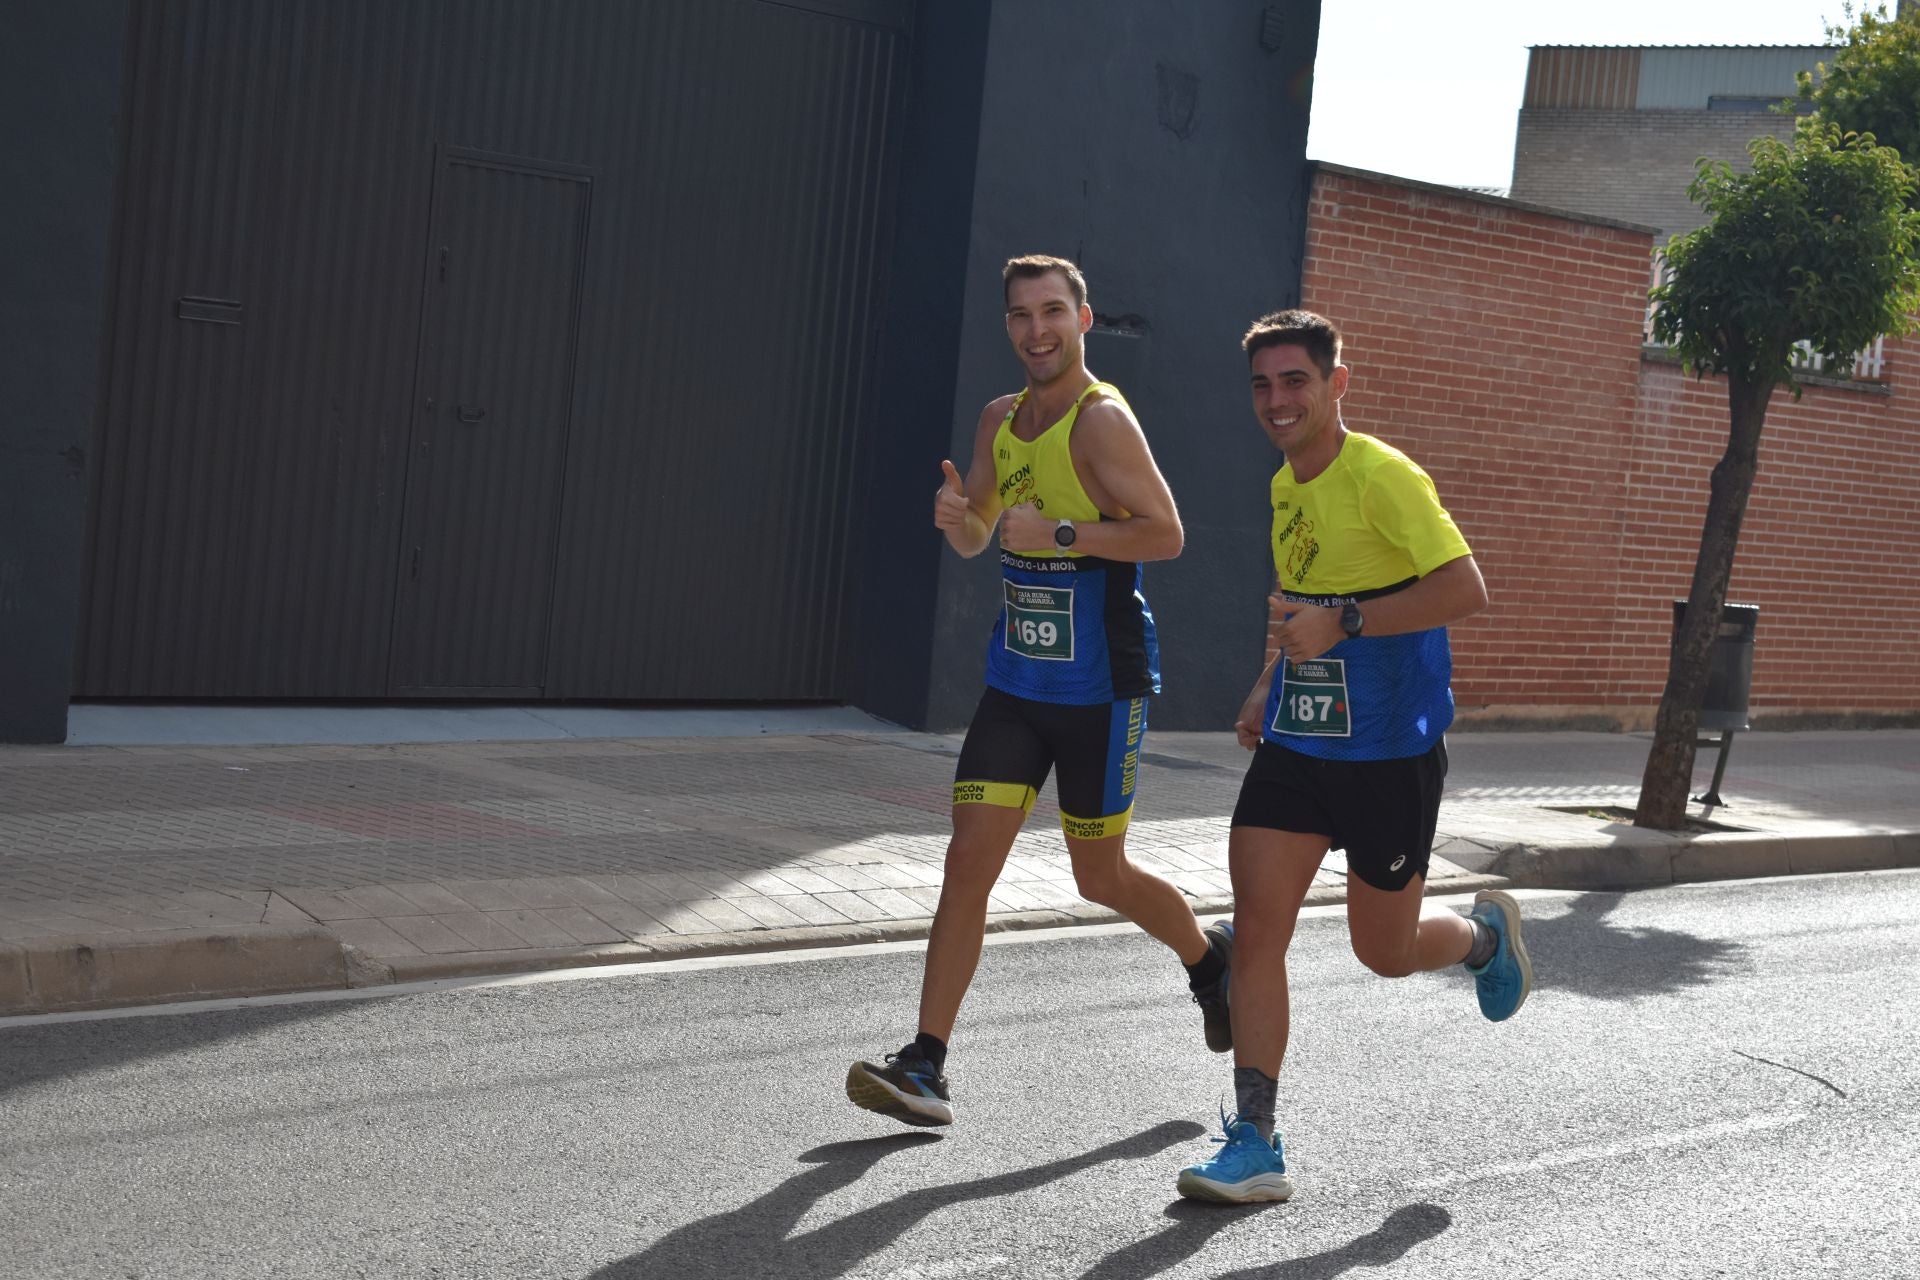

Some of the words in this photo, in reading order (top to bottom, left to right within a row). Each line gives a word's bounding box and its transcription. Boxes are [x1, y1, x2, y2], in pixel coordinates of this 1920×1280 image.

[1050, 562, 1077, 571] RIOJA
[1014, 617, 1057, 647] 169
[1289, 694, 1333, 721] 187
[1065, 818, 1104, 830] RINCÓN
